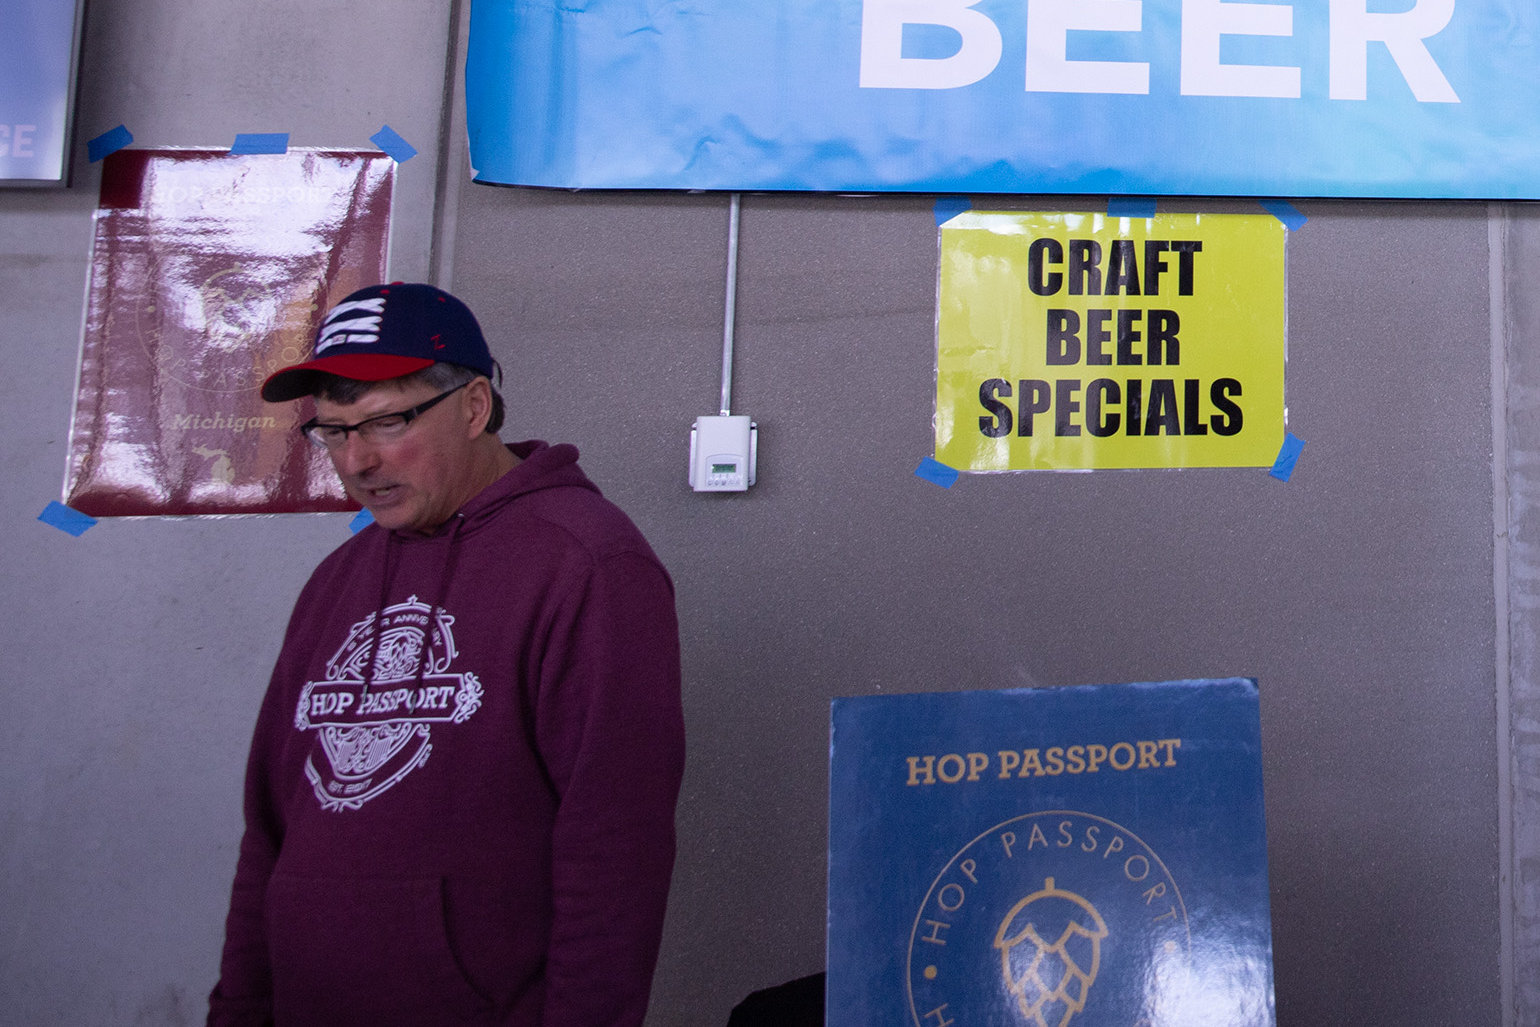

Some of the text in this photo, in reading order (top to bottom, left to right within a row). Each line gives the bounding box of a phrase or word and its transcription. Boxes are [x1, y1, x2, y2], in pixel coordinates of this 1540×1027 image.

[1027, 237, 1203, 296] CRAFT
[1045, 308, 1181, 366] BEER
[172, 411, 277, 434] Michigan
[978, 377, 1244, 438] SPECIALS
[311, 685, 455, 717] HOP PASSPORT
[905, 738, 1181, 786] HOP PASSPORT
[921, 821, 1178, 947] HOP PASSPORT
